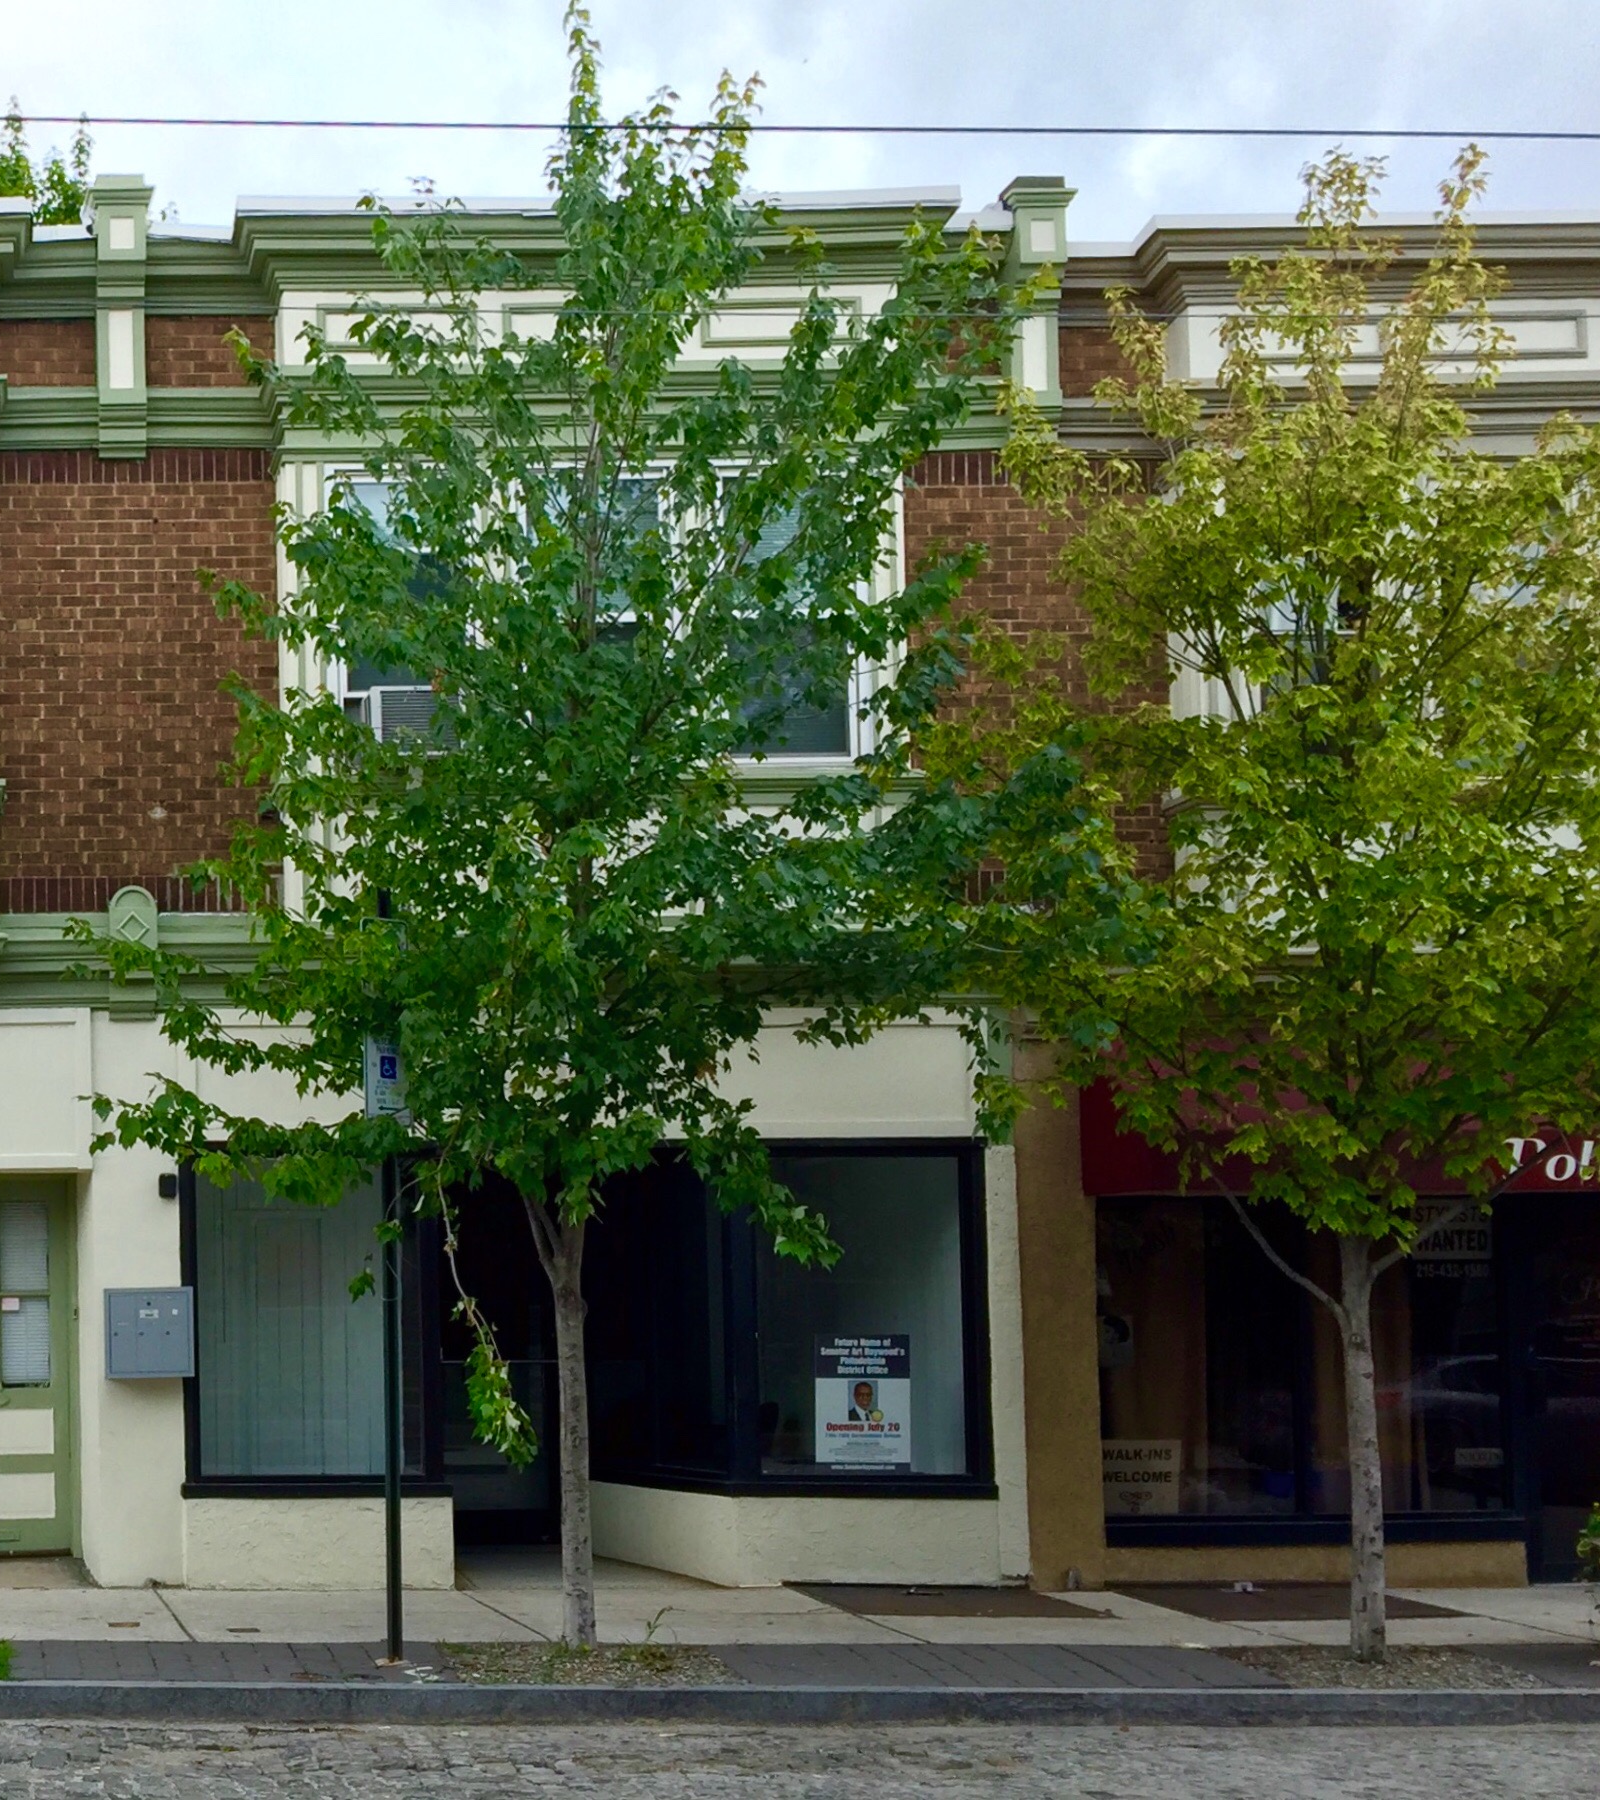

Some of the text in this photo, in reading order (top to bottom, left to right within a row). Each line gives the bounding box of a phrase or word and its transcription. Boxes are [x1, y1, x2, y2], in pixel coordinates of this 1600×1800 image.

[826, 1422, 900, 1433] Opening July 20
[1103, 1448, 1172, 1461] WALK-INS
[1103, 1471, 1172, 1483] WELCOME
